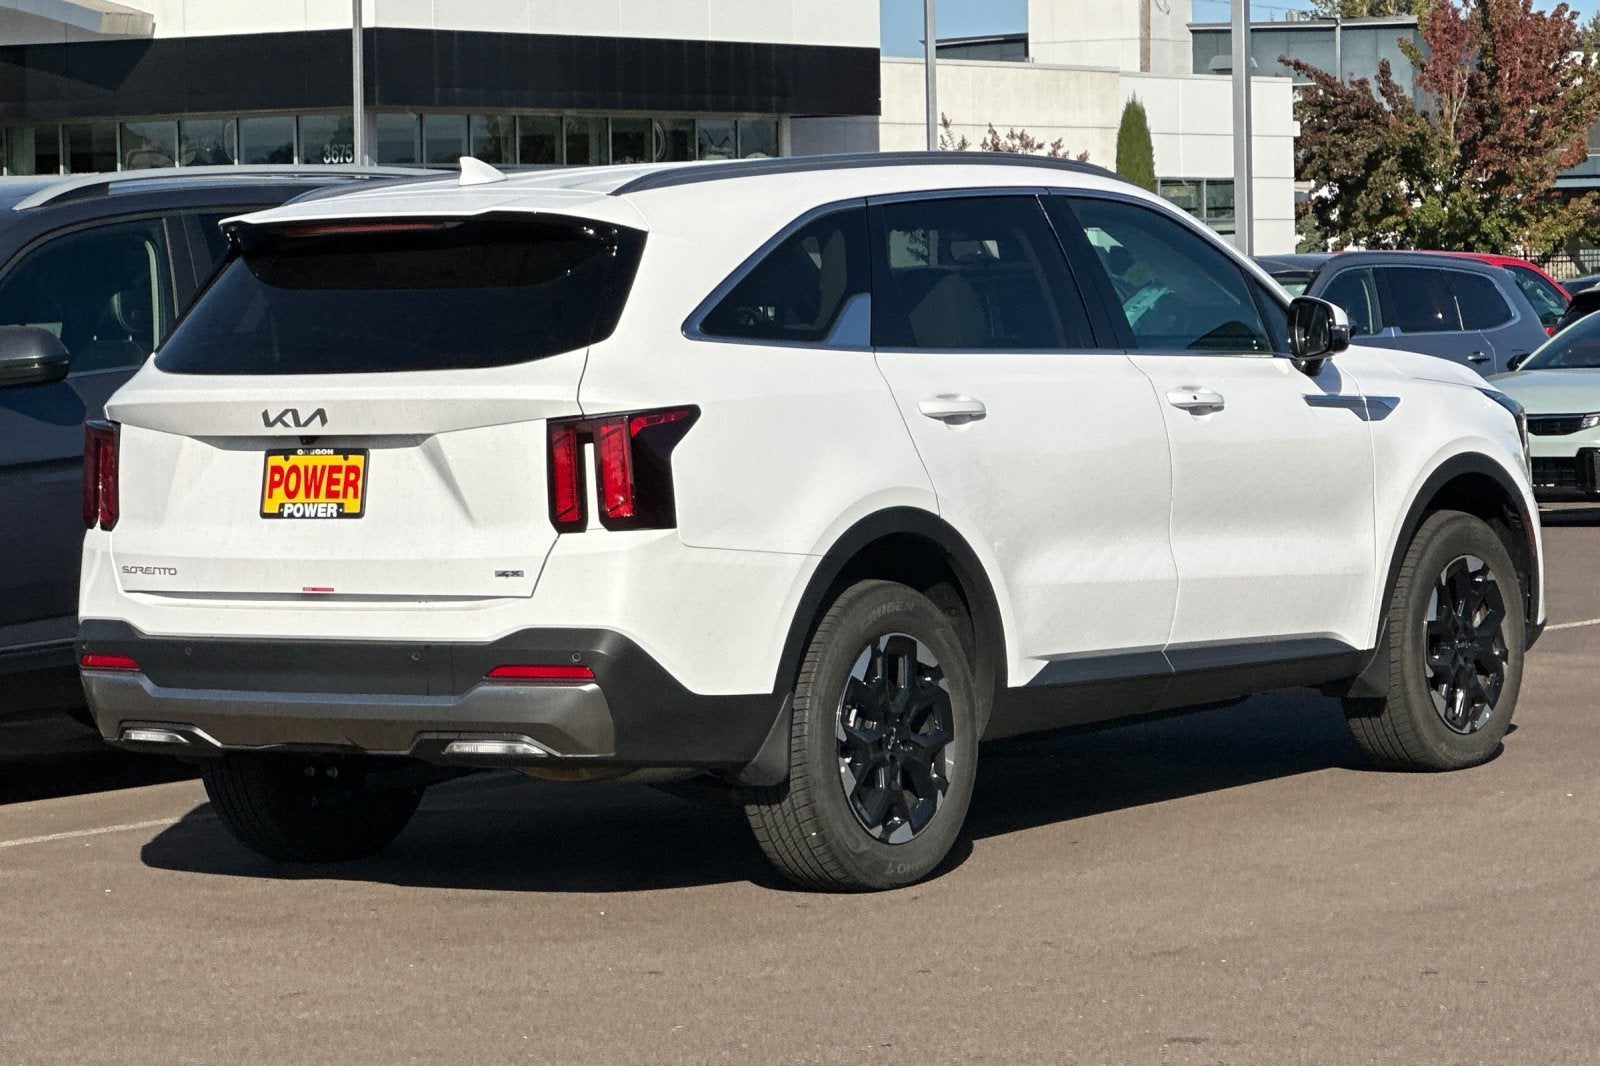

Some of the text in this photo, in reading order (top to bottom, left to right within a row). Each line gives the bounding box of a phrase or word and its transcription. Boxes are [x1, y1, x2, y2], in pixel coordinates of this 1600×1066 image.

[323, 144, 353, 164] 3675
[262, 408, 328, 428] KIA
[267, 464, 361, 500] POWER
[283, 503, 338, 518] POWER
[121, 565, 178, 576] SORENTO
